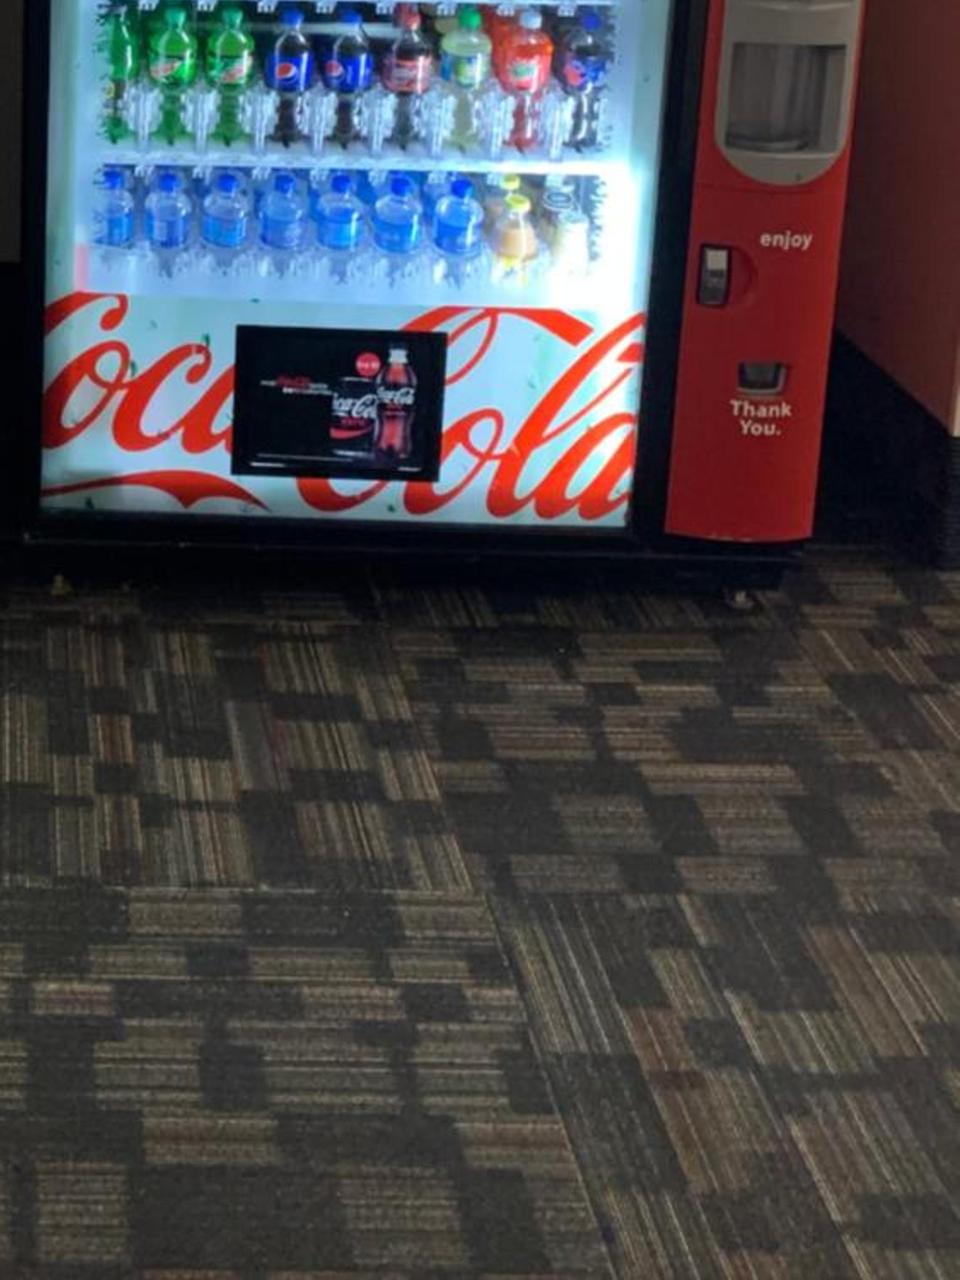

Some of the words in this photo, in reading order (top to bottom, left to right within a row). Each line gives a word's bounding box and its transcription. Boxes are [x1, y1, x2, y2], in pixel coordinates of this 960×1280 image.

[759, 231, 814, 251] enjoy
[729, 399, 793, 418] Thank
[739, 419, 782, 437] You.
